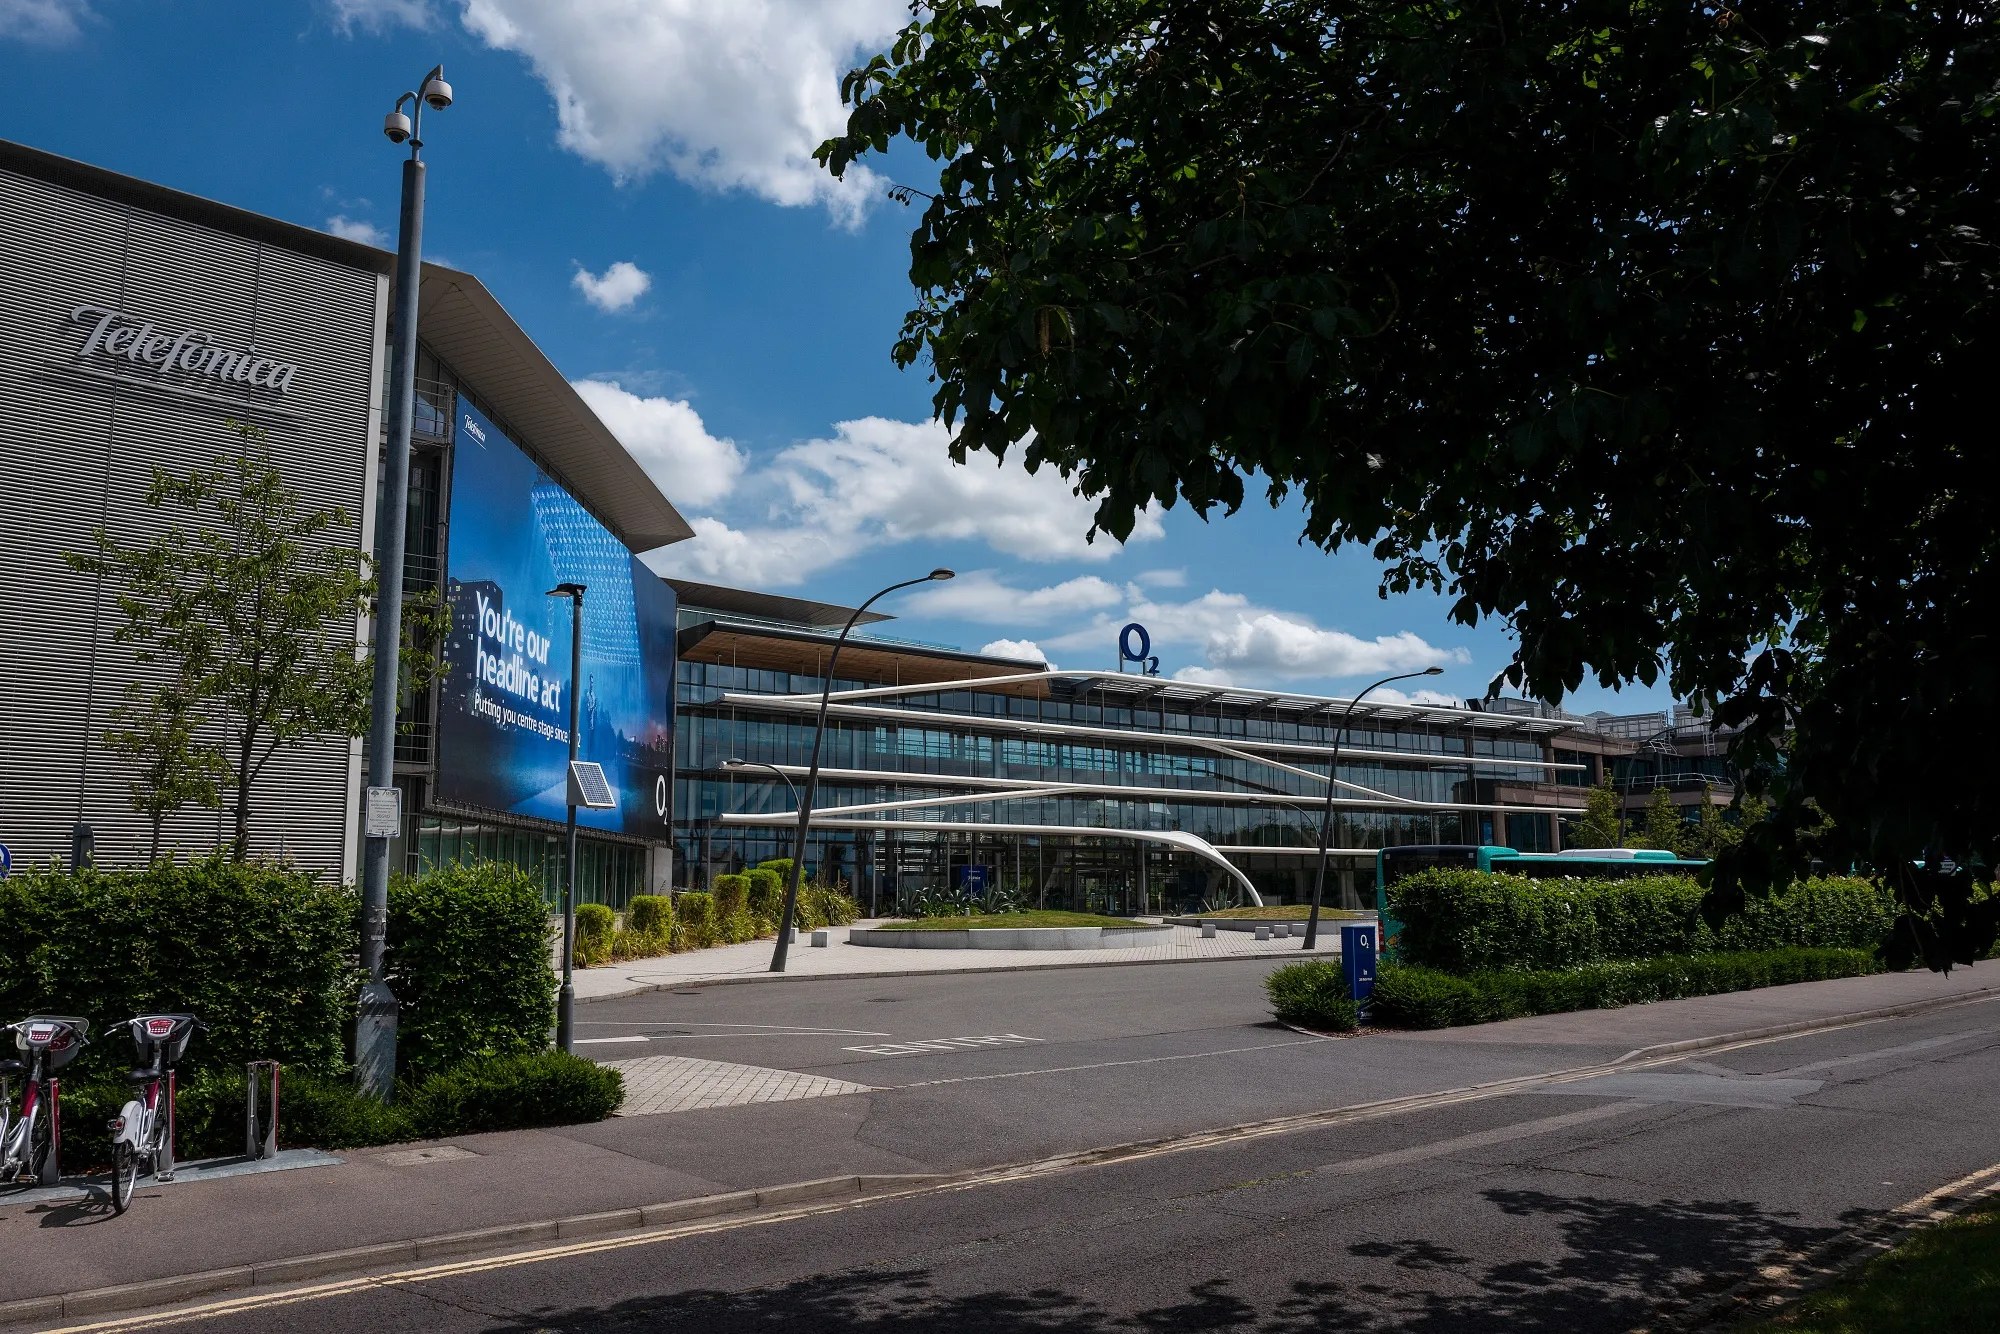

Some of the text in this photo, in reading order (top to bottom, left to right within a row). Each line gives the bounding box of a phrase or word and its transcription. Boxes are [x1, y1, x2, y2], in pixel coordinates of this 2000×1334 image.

[71, 305, 298, 394] Telefónica
[476, 590, 550, 665] You're our
[476, 636, 561, 713] headline act
[474, 692, 502, 723] Putting
[502, 708, 516, 726] you
[517, 713, 538, 732] centre
[538, 719, 554, 741] stage
[554, 724, 568, 744] since
[841, 1033, 1046, 1055] ENTRY
